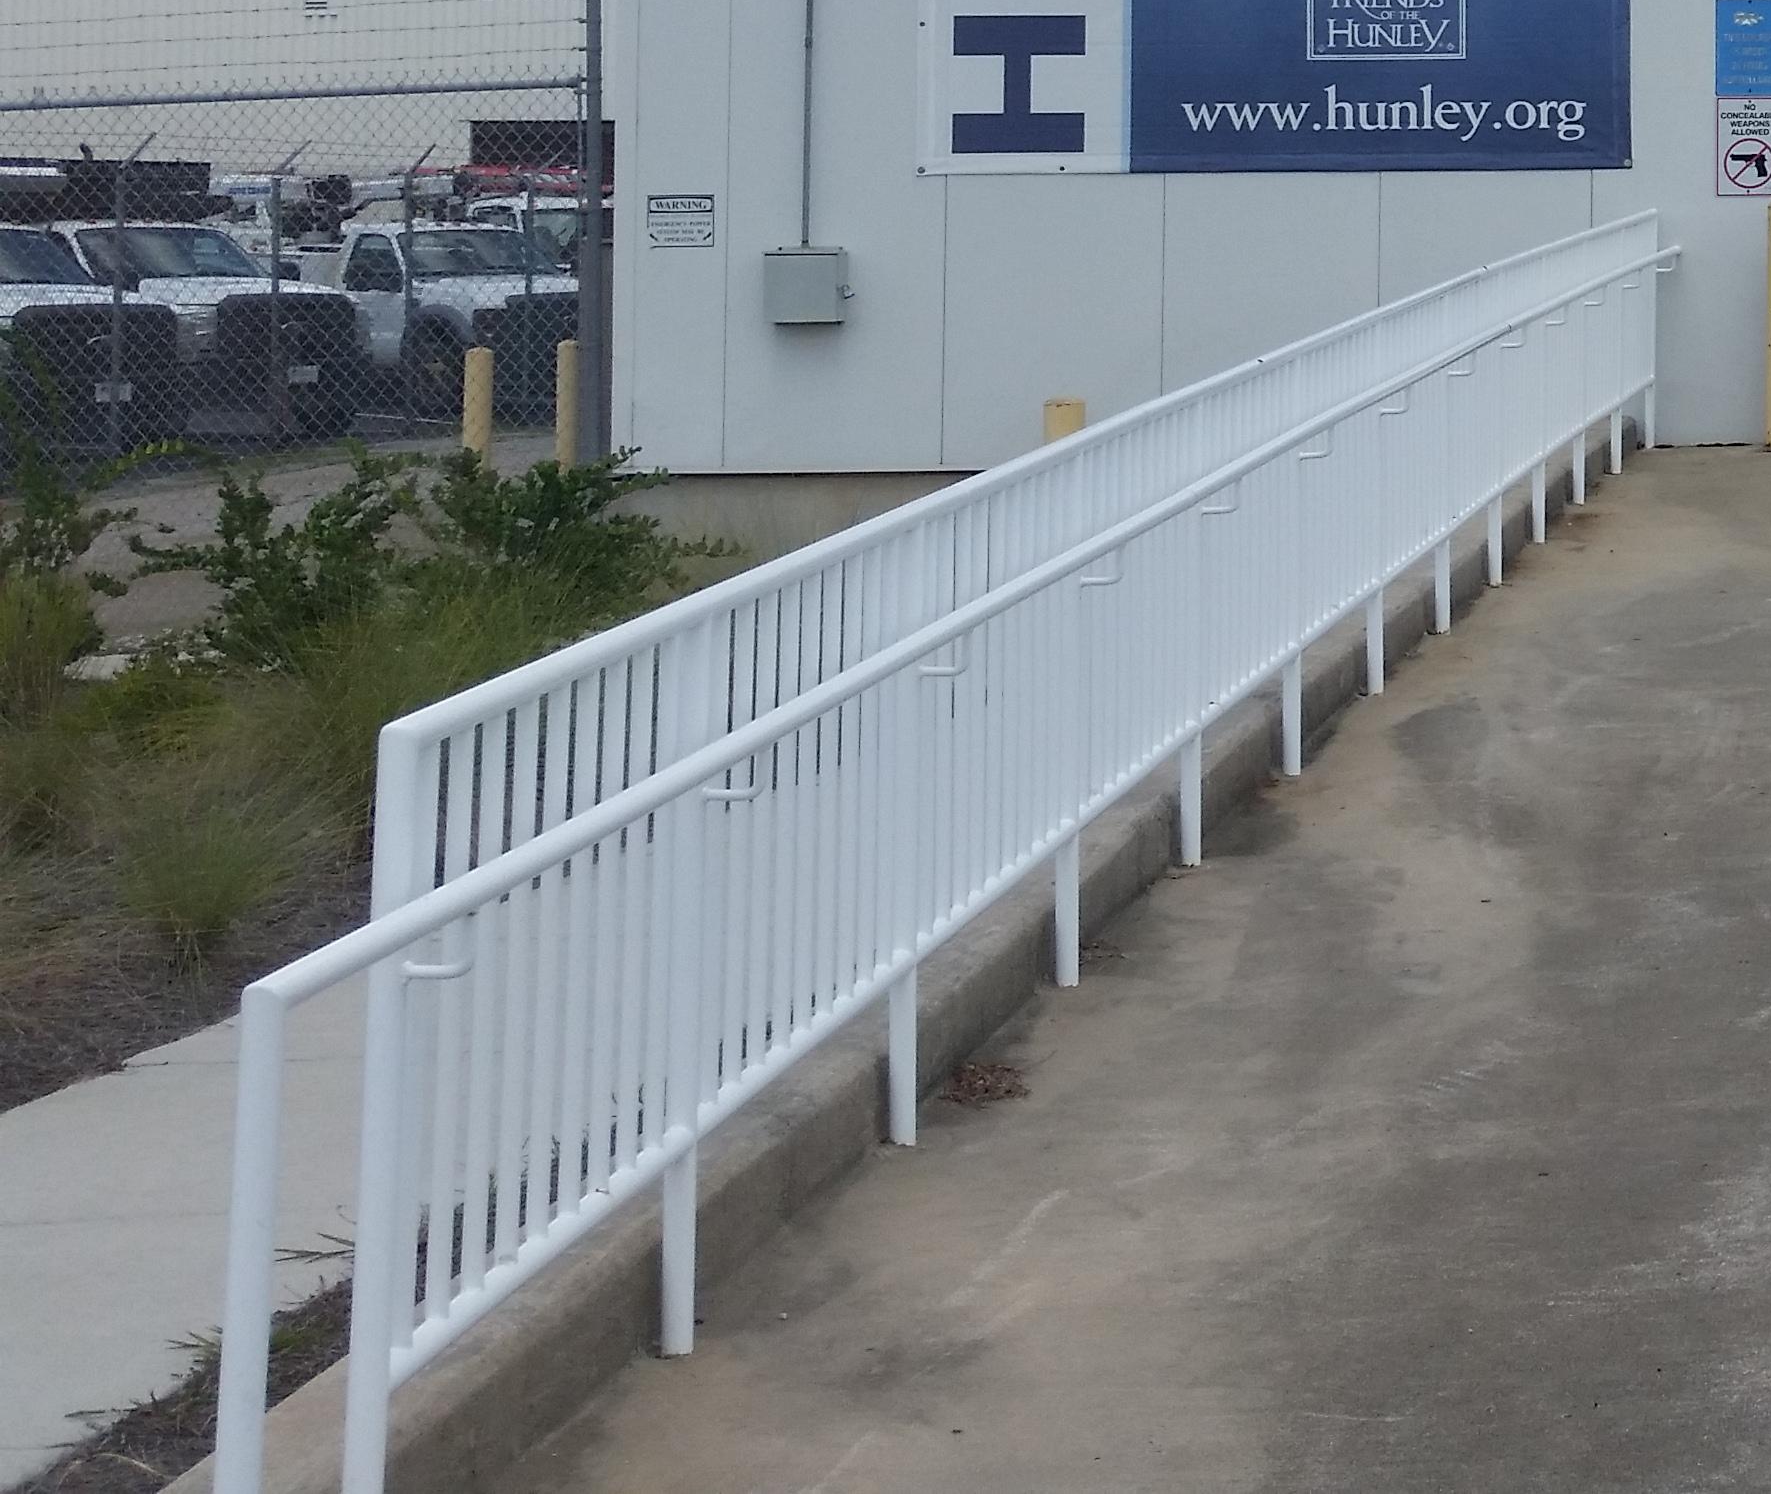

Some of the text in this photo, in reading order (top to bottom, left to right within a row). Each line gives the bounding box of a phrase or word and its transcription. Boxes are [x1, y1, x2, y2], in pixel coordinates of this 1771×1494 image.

[1380, 10, 1420, 21] OF THE
[1327, 18, 1451, 53] HUNLEY
[1181, 84, 1587, 142] www.hunley.org
[655, 201, 707, 209] WARNING
